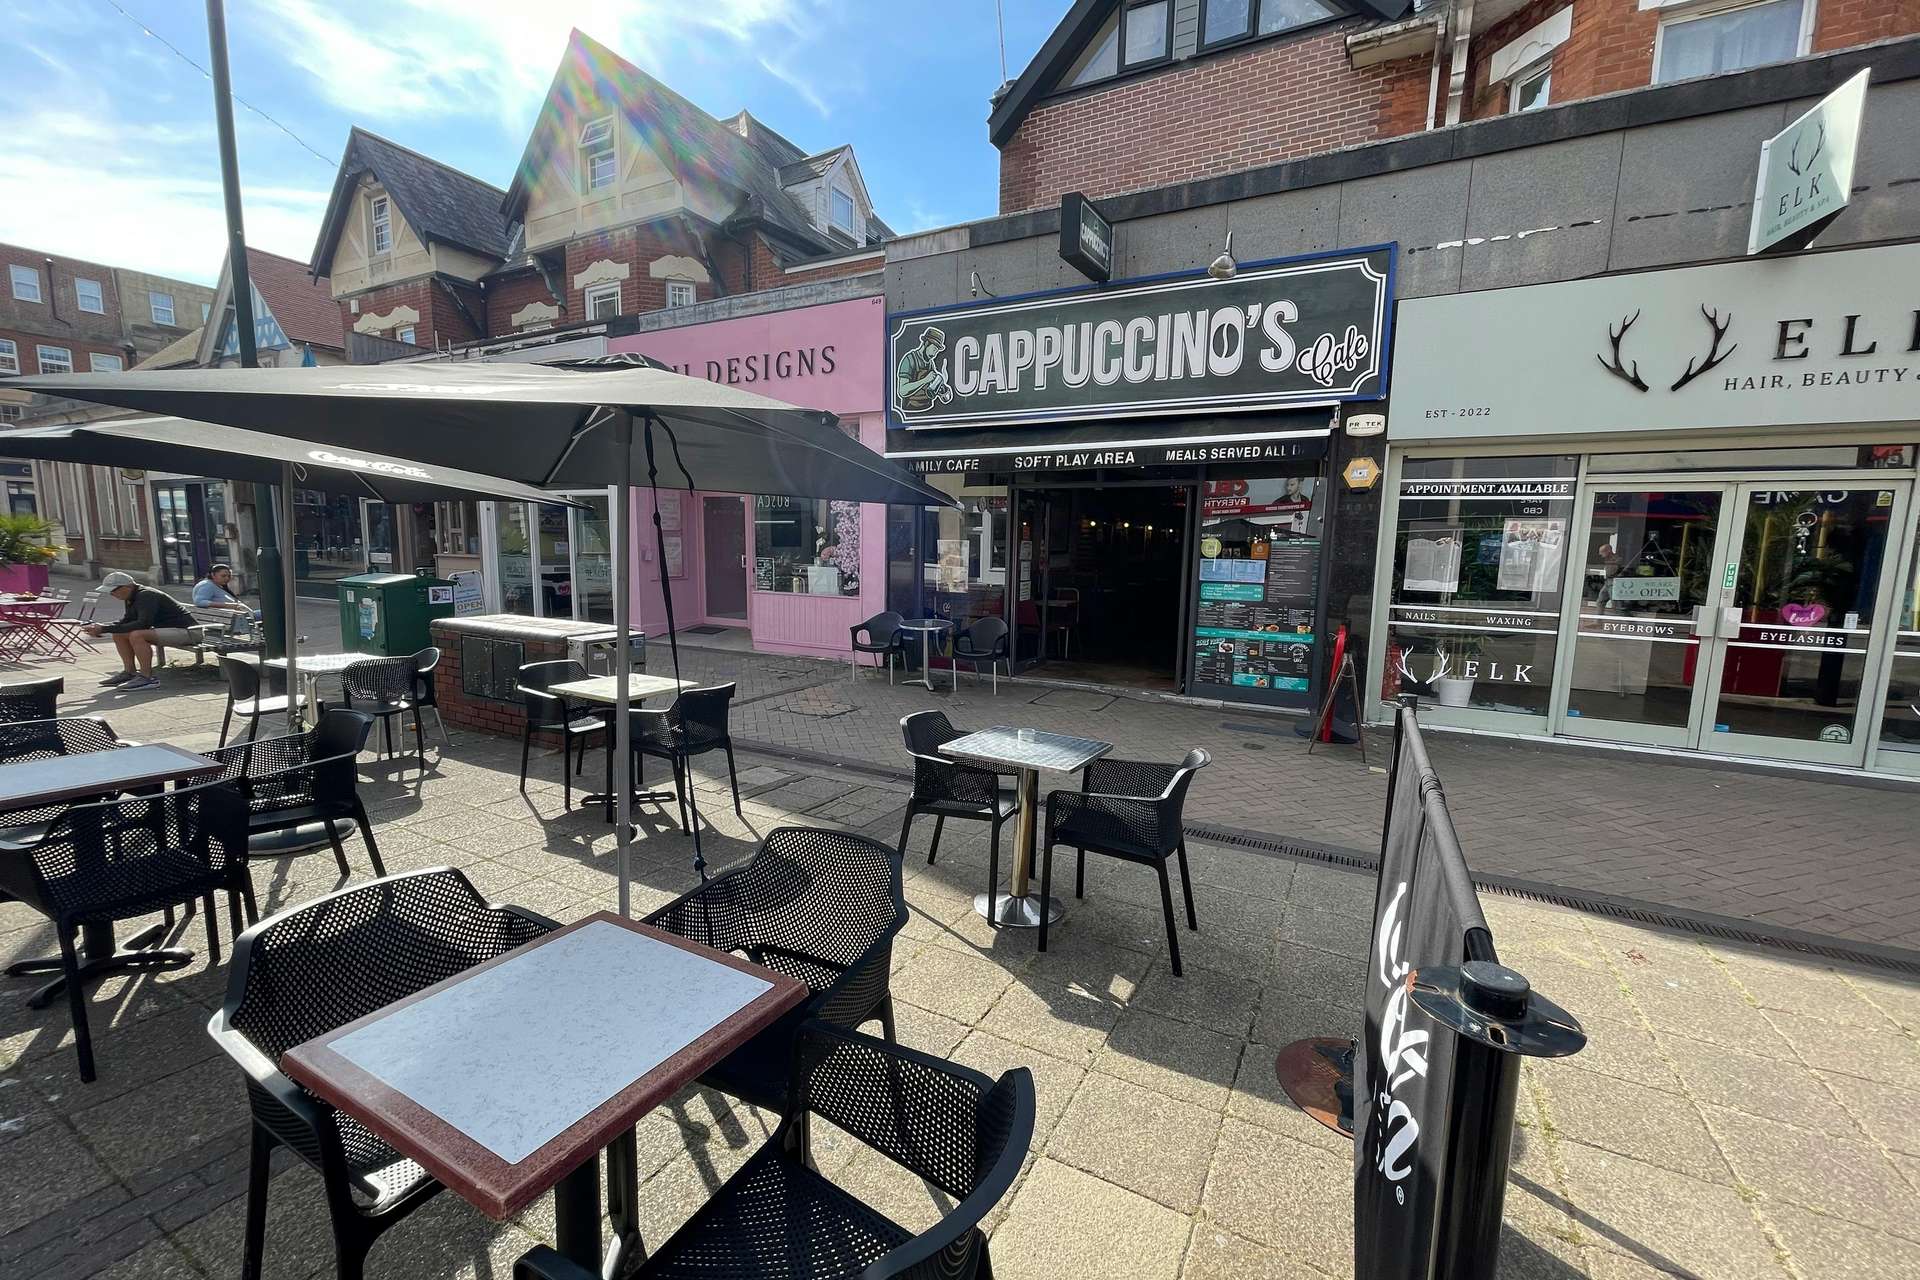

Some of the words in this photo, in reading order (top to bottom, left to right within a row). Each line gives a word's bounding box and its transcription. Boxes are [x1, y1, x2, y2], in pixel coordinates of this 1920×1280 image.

[1778, 172, 1822, 217] ELK
[953, 299, 1300, 398] CAPPUCCINO'S
[1296, 324, 1369, 387] Cafe
[706, 345, 836, 384] DESIGNS
[1724, 374, 1792, 392] HAIR,
[1802, 367, 1909, 387] BEAUTY
[1014, 455, 1052, 468] SOFT
[1055, 453, 1090, 467] PLAY
[1093, 451, 1136, 465] AREA
[1165, 449, 1207, 461] MEALS
[1210, 446, 1261, 459] SERVED
[1264, 444, 1287, 457] ALL
[908, 459, 943, 473] AMILY
[946, 458, 981, 471] CAFE
[1406, 484, 1496, 495] APPOINTMENT
[1498, 483, 1569, 494] AVAILABLE
[1726, 564, 1735, 587] PUSH
[1639, 588, 1674, 597] OPEN
[456, 600, 483, 610] OPEN
[1405, 612, 1436, 621] NAILS
[1486, 615, 1532, 626] WAXING
[1603, 622, 1675, 635] EYEBROWS
[1760, 632, 1845, 646] EYELASHES
[1464, 660, 1534, 683] ELK
